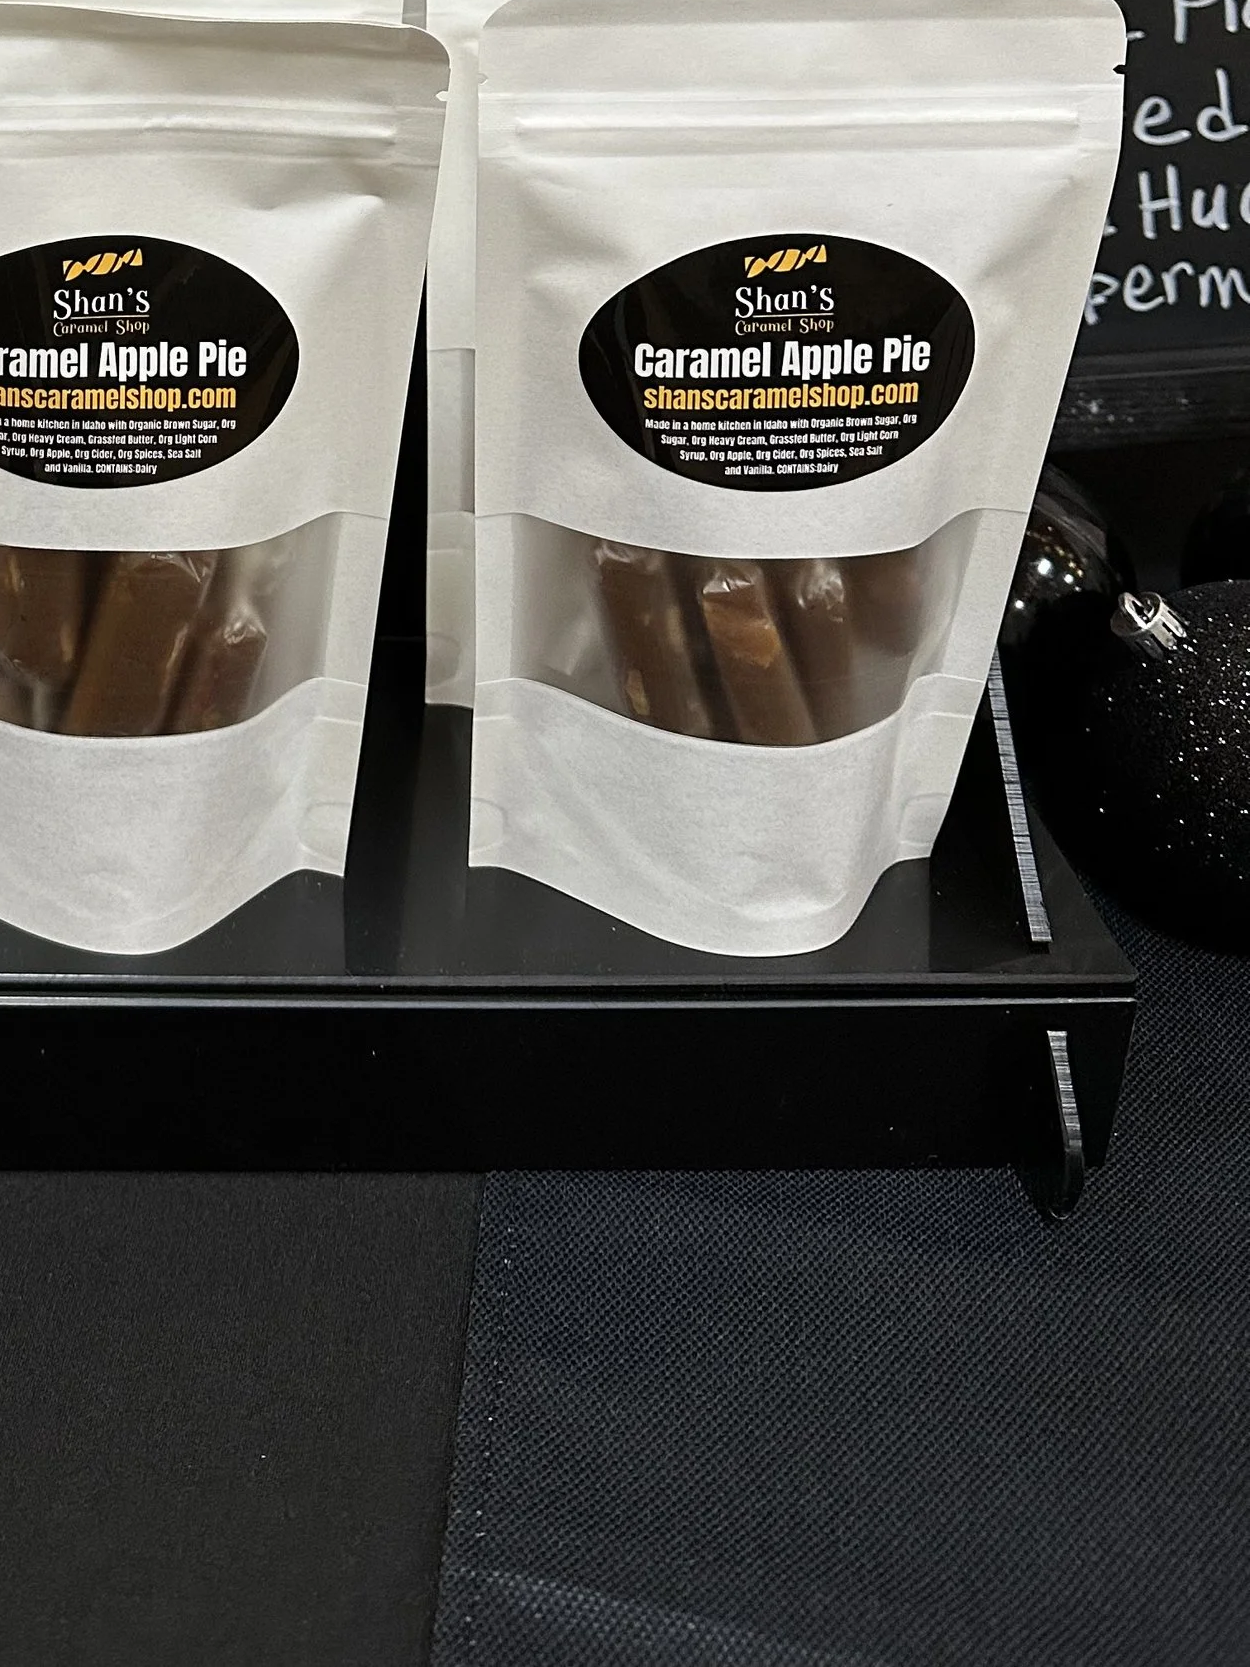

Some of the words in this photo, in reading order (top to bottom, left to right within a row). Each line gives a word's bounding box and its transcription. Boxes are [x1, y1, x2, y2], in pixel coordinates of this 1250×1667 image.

[53, 287, 149, 321] Shan's
[735, 285, 834, 319] Shan's
[53, 320, 107, 336] Caramel
[115, 319, 149, 334] Shop
[735, 318, 791, 335] Caramel
[799, 317, 833, 333] Shop
[98, 341, 188, 380] Apple
[198, 339, 246, 376] Pie
[634, 341, 771, 378] Caramel
[780, 338, 872, 377] Apple
[882, 335, 930, 372] Pie
[643, 381, 918, 410] shanscaramelshop.com
[44, 463, 60, 472] and
